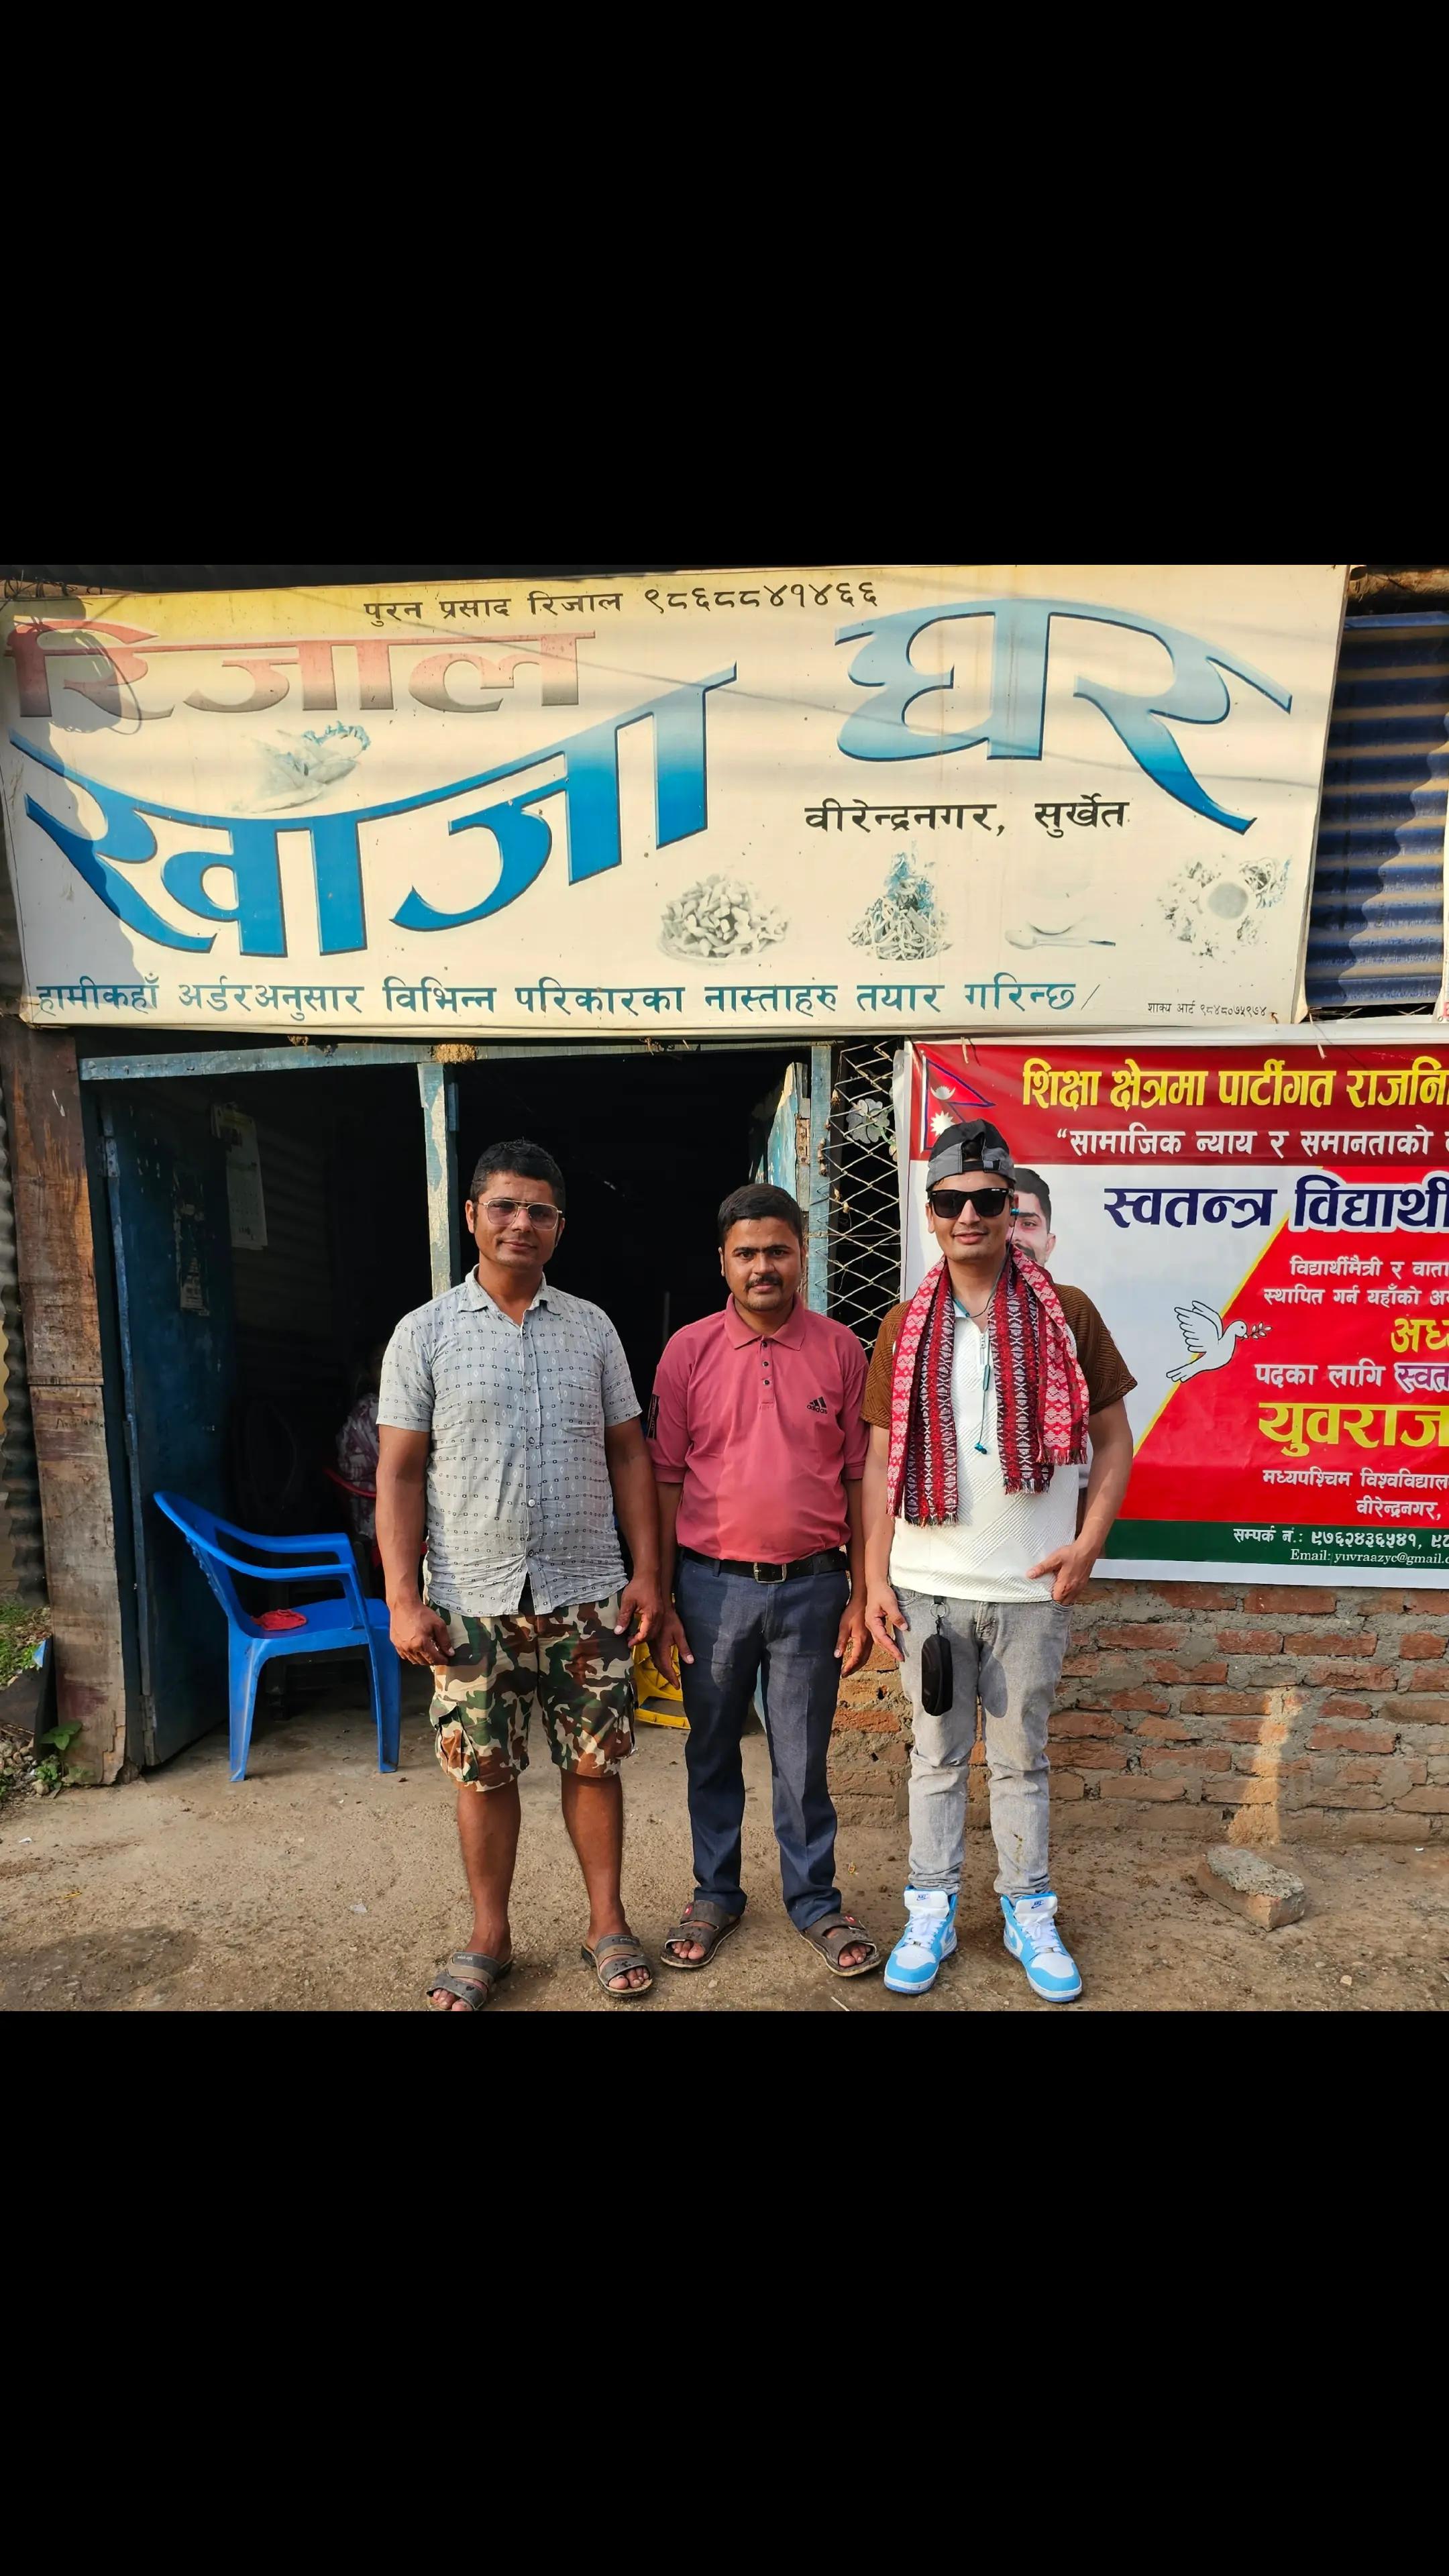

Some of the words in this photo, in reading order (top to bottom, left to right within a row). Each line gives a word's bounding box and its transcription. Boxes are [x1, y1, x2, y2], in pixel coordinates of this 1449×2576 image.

[363, 601, 423, 627] पुरन
[439, 598, 511, 619] प्रसाद
[527, 590, 624, 616] रिजाल
[644, 581, 878, 614] ९८६८८४१४६६
[4, 618, 596, 720] रिजाल
[9, 662, 737, 957] खाजा
[835, 598, 1293, 835] घर
[804, 798, 1006, 837] वीरेन्द्रनगर,
[1034, 793, 1130, 839] सुर्खेत
[36, 972, 160, 1016] हामीकहाँ
[382, 975, 497, 1014] विभिन्न
[515, 975, 686, 1016] परिकारका
[857, 983, 945, 1012] तयार
[1022, 1057, 1102, 1112] शिक्षा
[1110, 1058, 1209, 1112] क्षेत्रमा
[1218, 1058, 1337, 1108] पार्टीगत
[1346, 1055, 1449, 1108] राजनि
[1195, 1130, 1258, 1155] न्याय
[1268, 1130, 1290, 1159] र
[1299, 1124, 1434, 1157] समानताको
[1104, 1187, 1278, 1229] स्वतन्त्र
[1389, 1261, 1405, 1280] र
[1263, 1283, 1326, 1305] स्थापित
[1332, 1285, 1360, 1305] गर्न
[1366, 1283, 1422, 1308] यहाँको
[1254, 1363, 1319, 1389] पदका
[1327, 1357, 1387, 1389] लागि
[806, 1404, 828, 1414] adidas
[1258, 1402, 1449, 1458] युवराज
[1360, 1466, 1449, 1491] विश्वविद्याल
[1355, 1495, 1442, 1521] वीरेन्द्रनगर,
[1233, 1525, 1277, 1544] सम्पर्क
[1289, 1548, 1331, 1562] Email:
